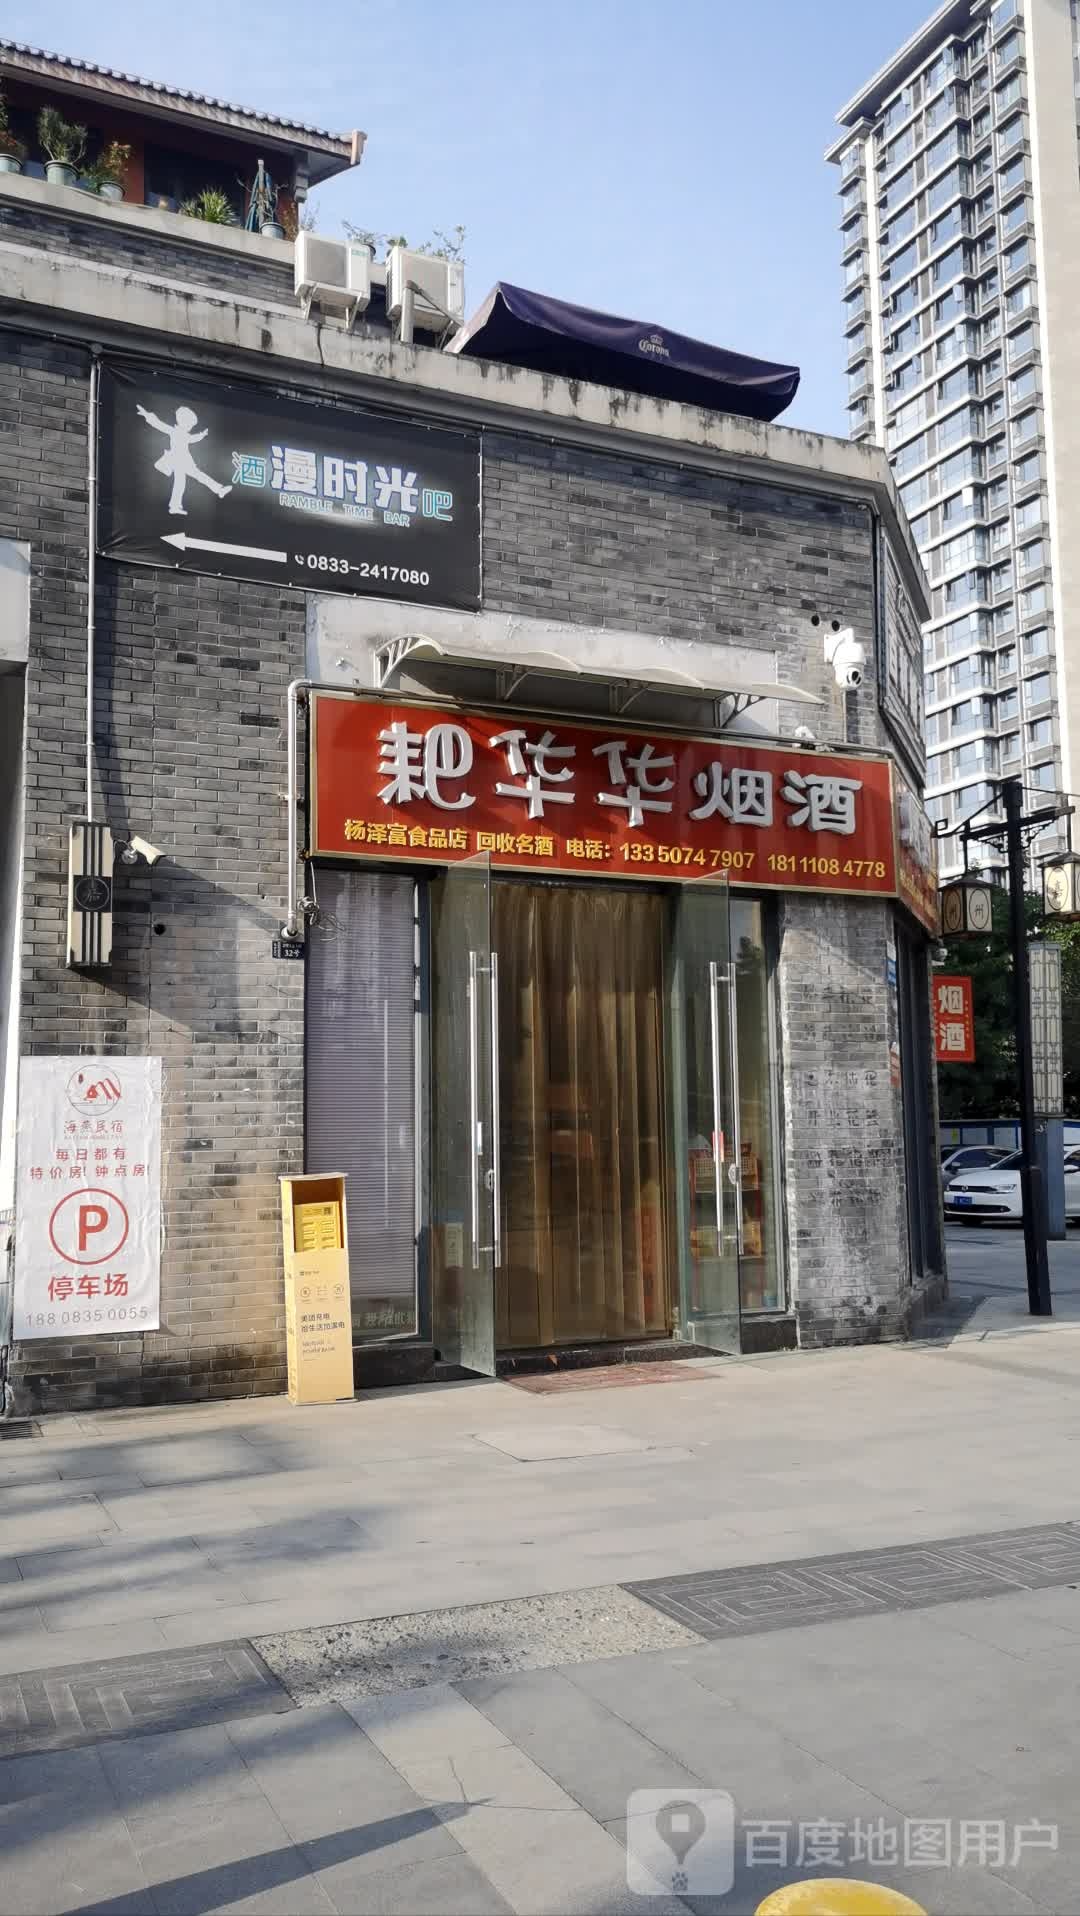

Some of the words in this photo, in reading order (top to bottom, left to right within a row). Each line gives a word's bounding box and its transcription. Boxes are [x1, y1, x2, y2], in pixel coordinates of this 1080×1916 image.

[639, 338, 670, 357] Corona
[279, 492, 333, 513] RAMBLE
[343, 503, 373, 521] TIME
[384, 512, 410, 527] BAR
[307, 555, 430, 586] 0833-2417080
[376, 721, 863, 836] 耙华华烟酒
[344, 819, 467, 849] 杨泽富食品店
[477, 831, 554, 856] 回收名酒
[938, 985, 965, 1051] 烟酒
[56, 1147, 126, 1161] 每日都有
[78, 1205, 109, 1251] P
[48, 1273, 128, 1301] 停车场
